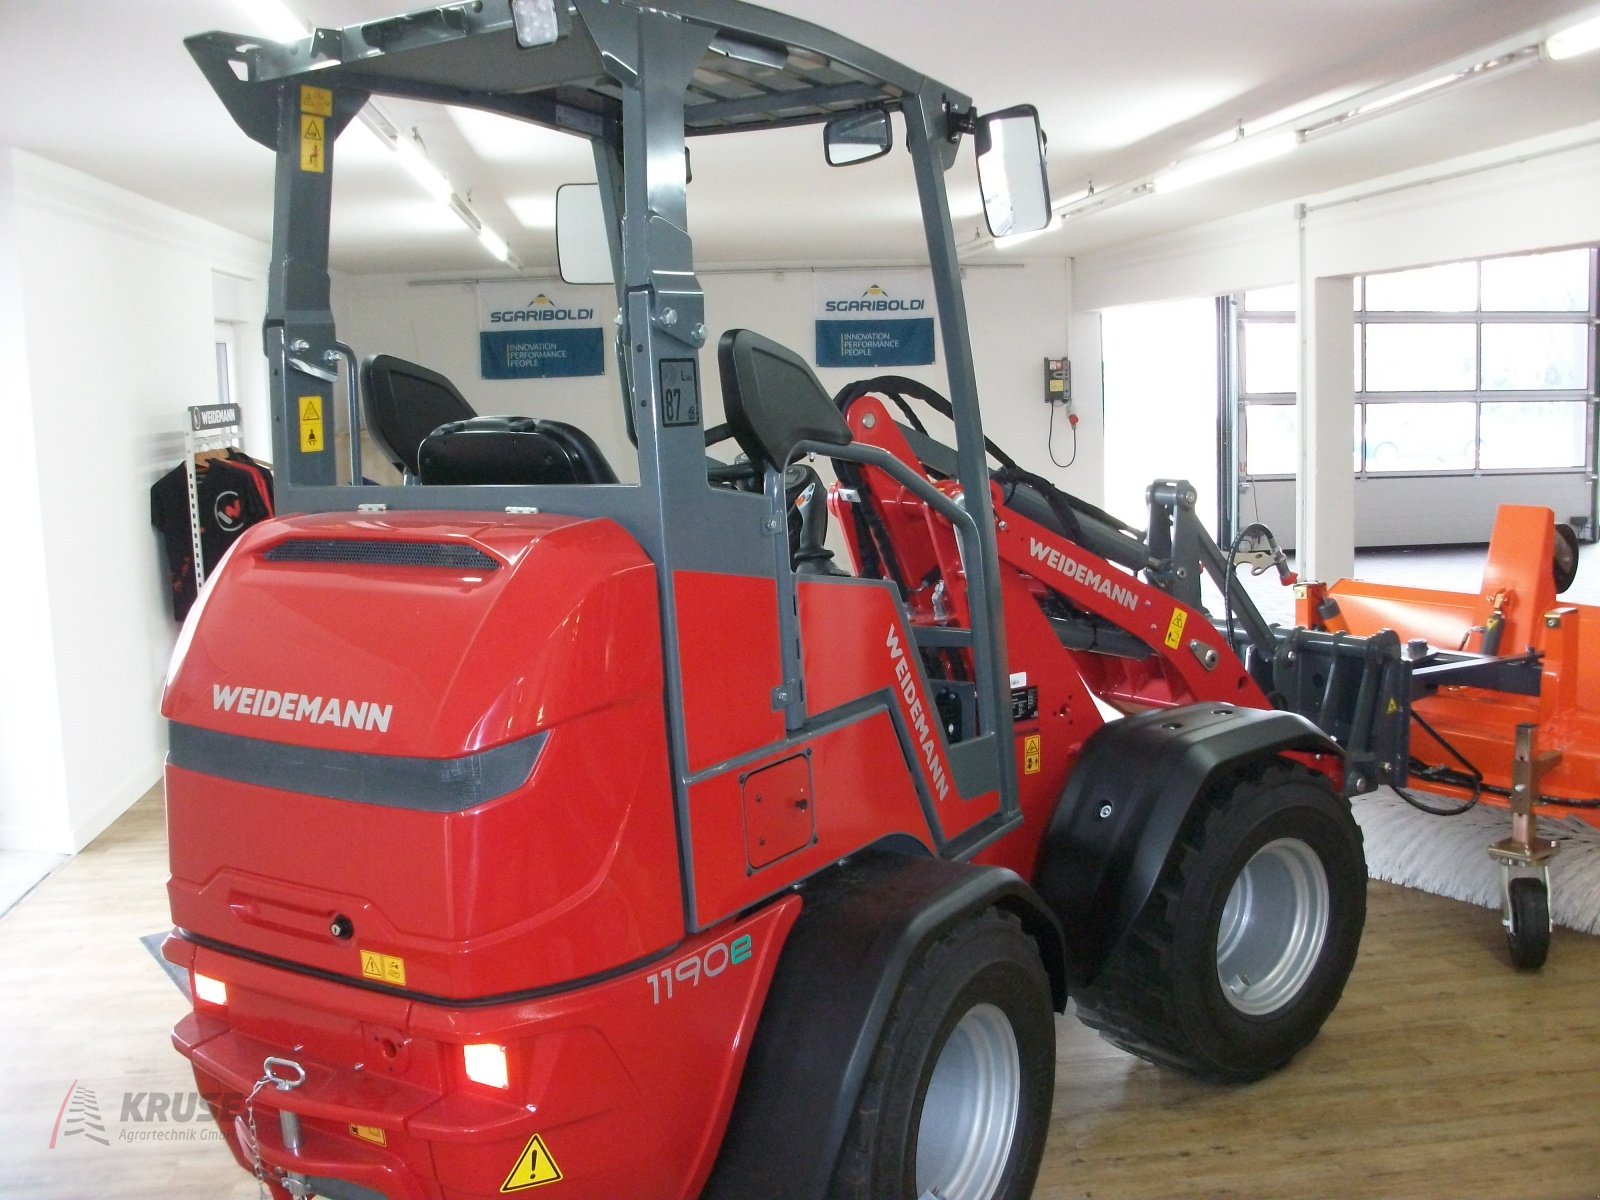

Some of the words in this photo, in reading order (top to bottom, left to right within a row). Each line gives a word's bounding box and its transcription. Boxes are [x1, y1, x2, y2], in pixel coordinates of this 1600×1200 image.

[825, 299, 924, 312] SGARIBOLDI
[490, 308, 593, 323] SGARIBOLDI
[510, 343, 557, 351] INNOVATION
[844, 340, 899, 348] PERFORMANCE
[510, 350, 567, 359] PERFORMANCE
[666, 388, 681, 420] 87
[201, 408, 236, 425] WEIDEMANN
[1029, 537, 1139, 610] WEIDEMANN
[213, 684, 393, 733] WEIDEMANN
[886, 623, 949, 801] WEIDEMANN
